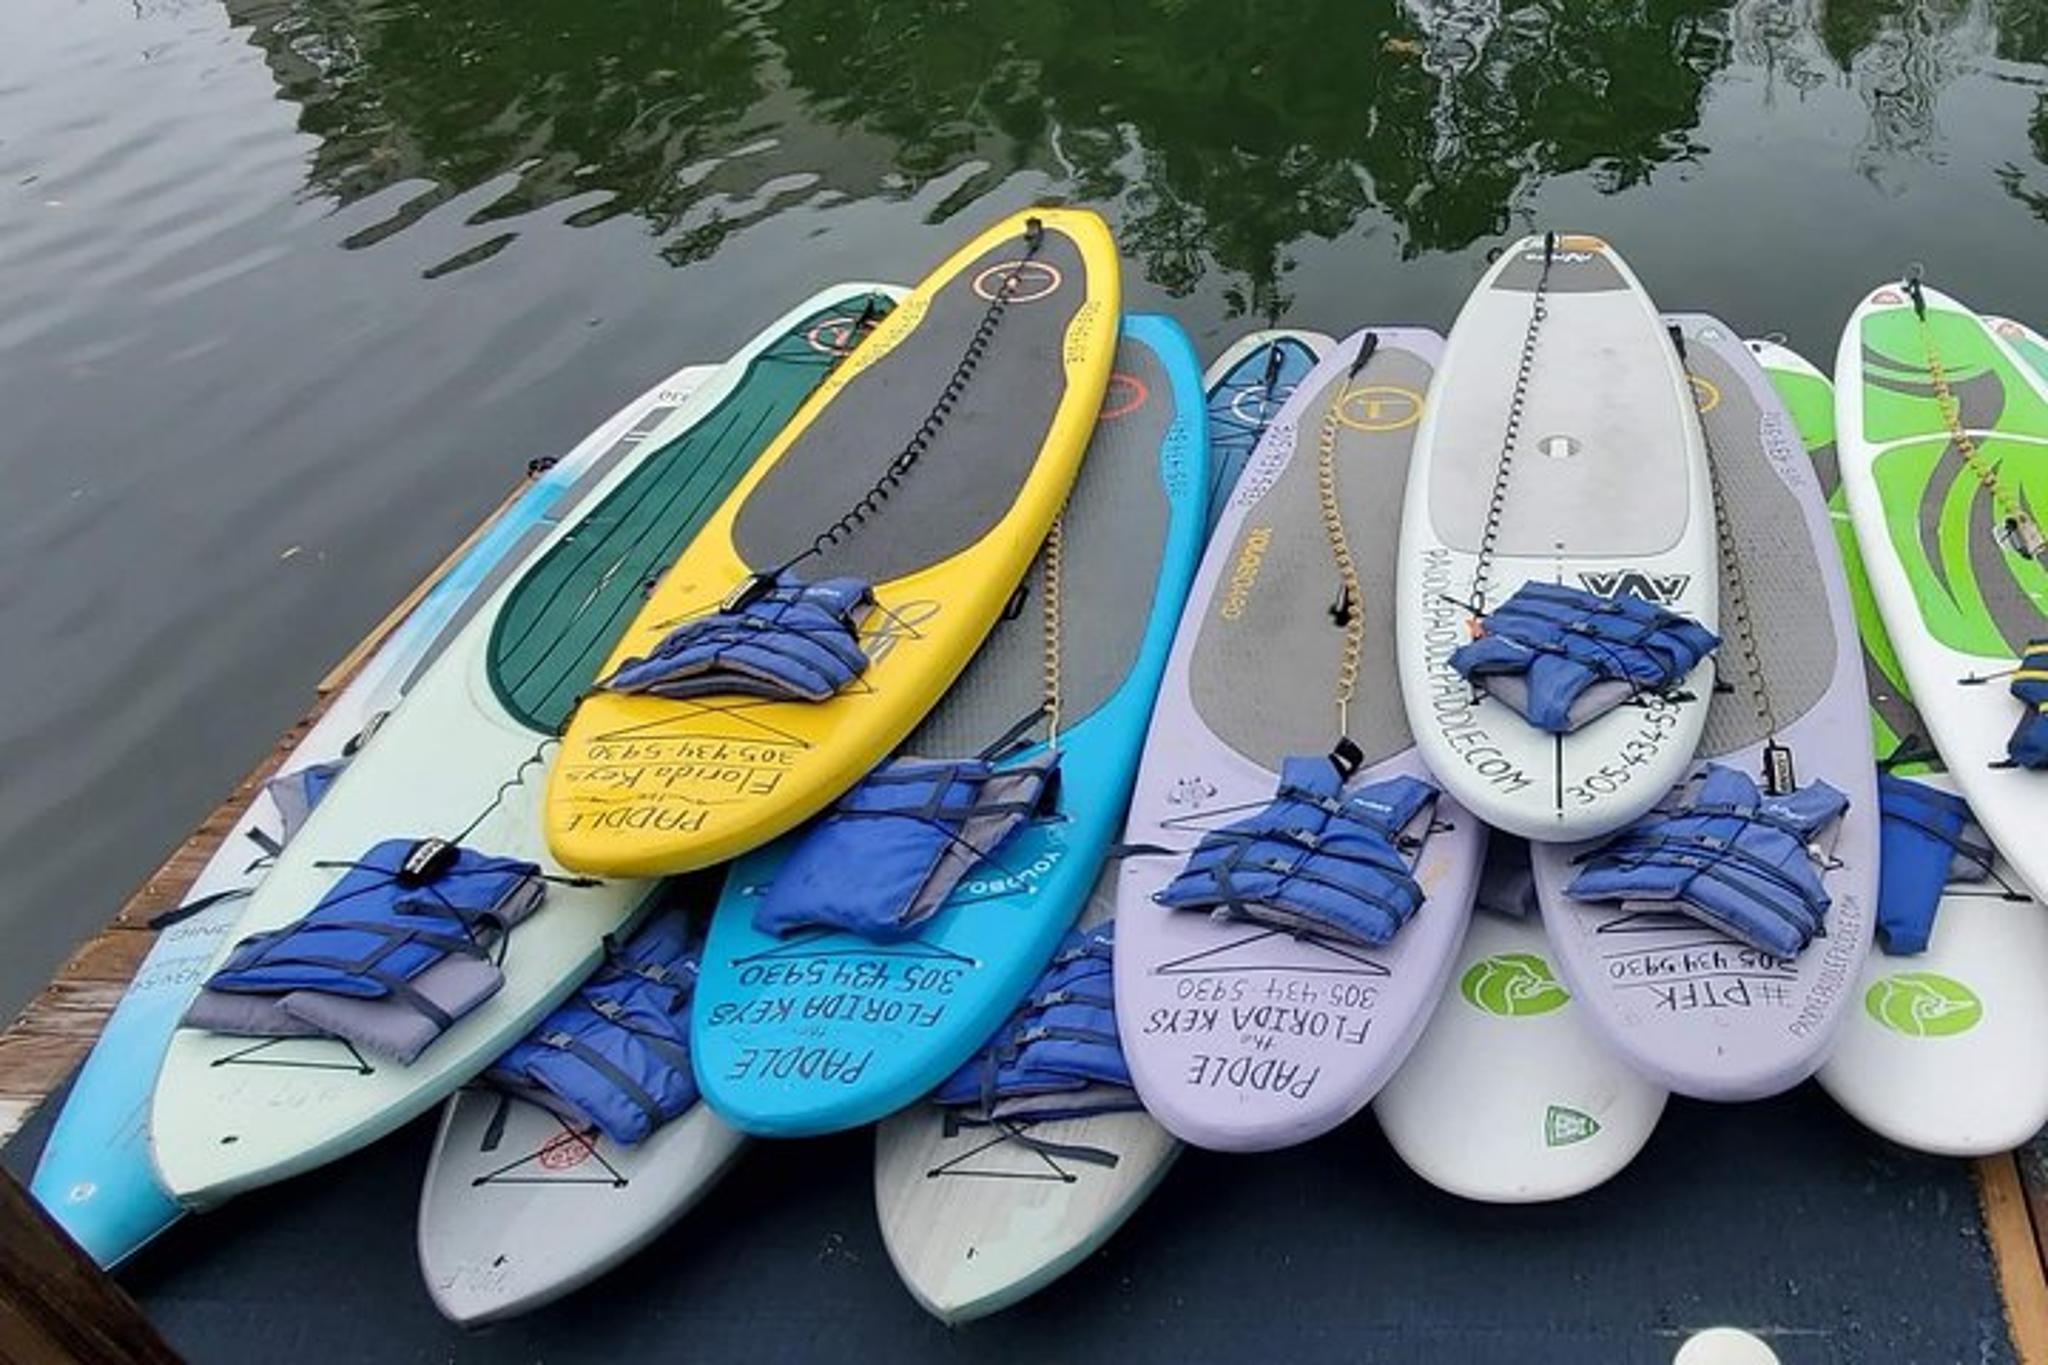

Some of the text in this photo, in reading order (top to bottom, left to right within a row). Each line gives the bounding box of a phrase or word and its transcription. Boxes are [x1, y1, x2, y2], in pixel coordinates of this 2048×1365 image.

[564, 765, 784, 795] Florida Keys
[566, 805, 709, 832] PADDLE
[707, 993, 947, 1028] FLORIDA KEYS
[1646, 978, 1789, 1012] #PTFK
[1143, 1006, 1372, 1045] FLORIDA KEYS
[724, 1046, 874, 1086] PADDLE
[1186, 1054, 1321, 1100] PADDLE
